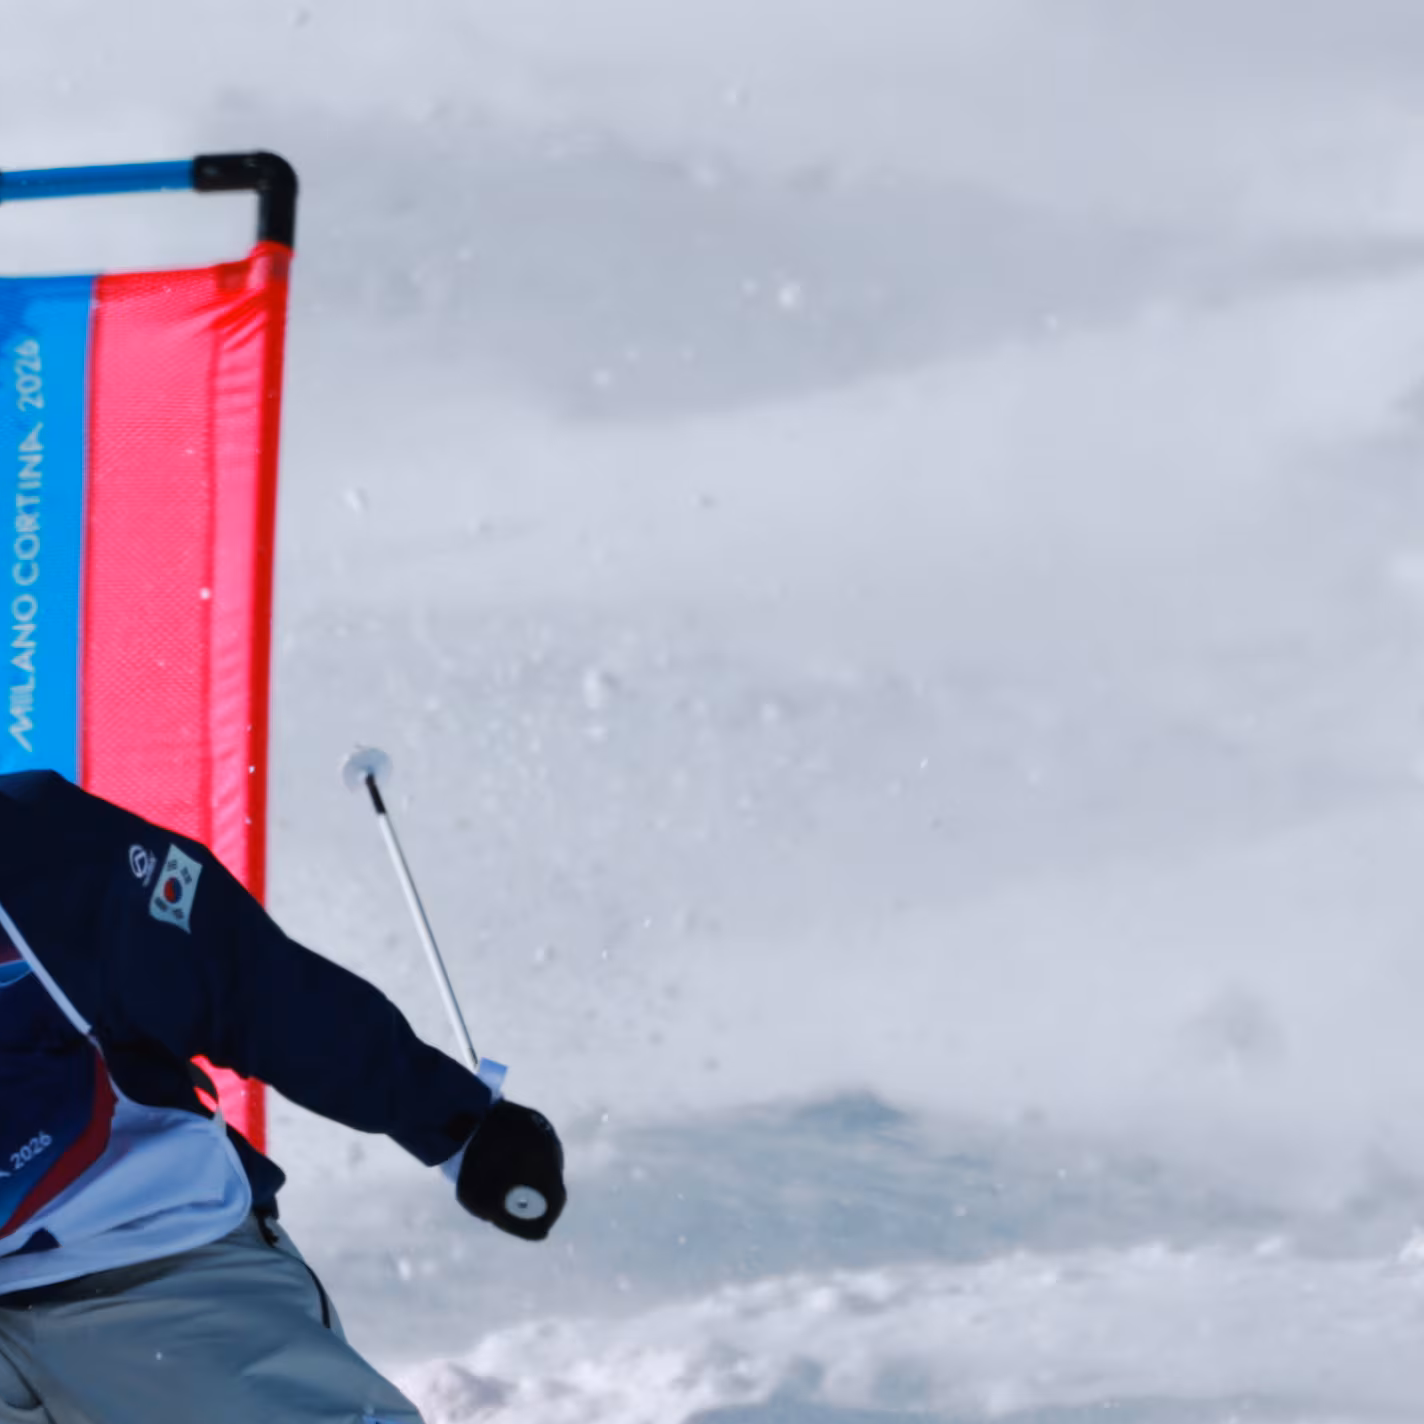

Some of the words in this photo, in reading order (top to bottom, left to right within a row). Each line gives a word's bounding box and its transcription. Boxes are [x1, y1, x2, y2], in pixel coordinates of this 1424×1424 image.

[14, 338, 45, 413] 2026
[12, 421, 44, 586] CORTINA
[9, 593, 39, 752] MILANO
[9, 1130, 53, 1170] 2026
